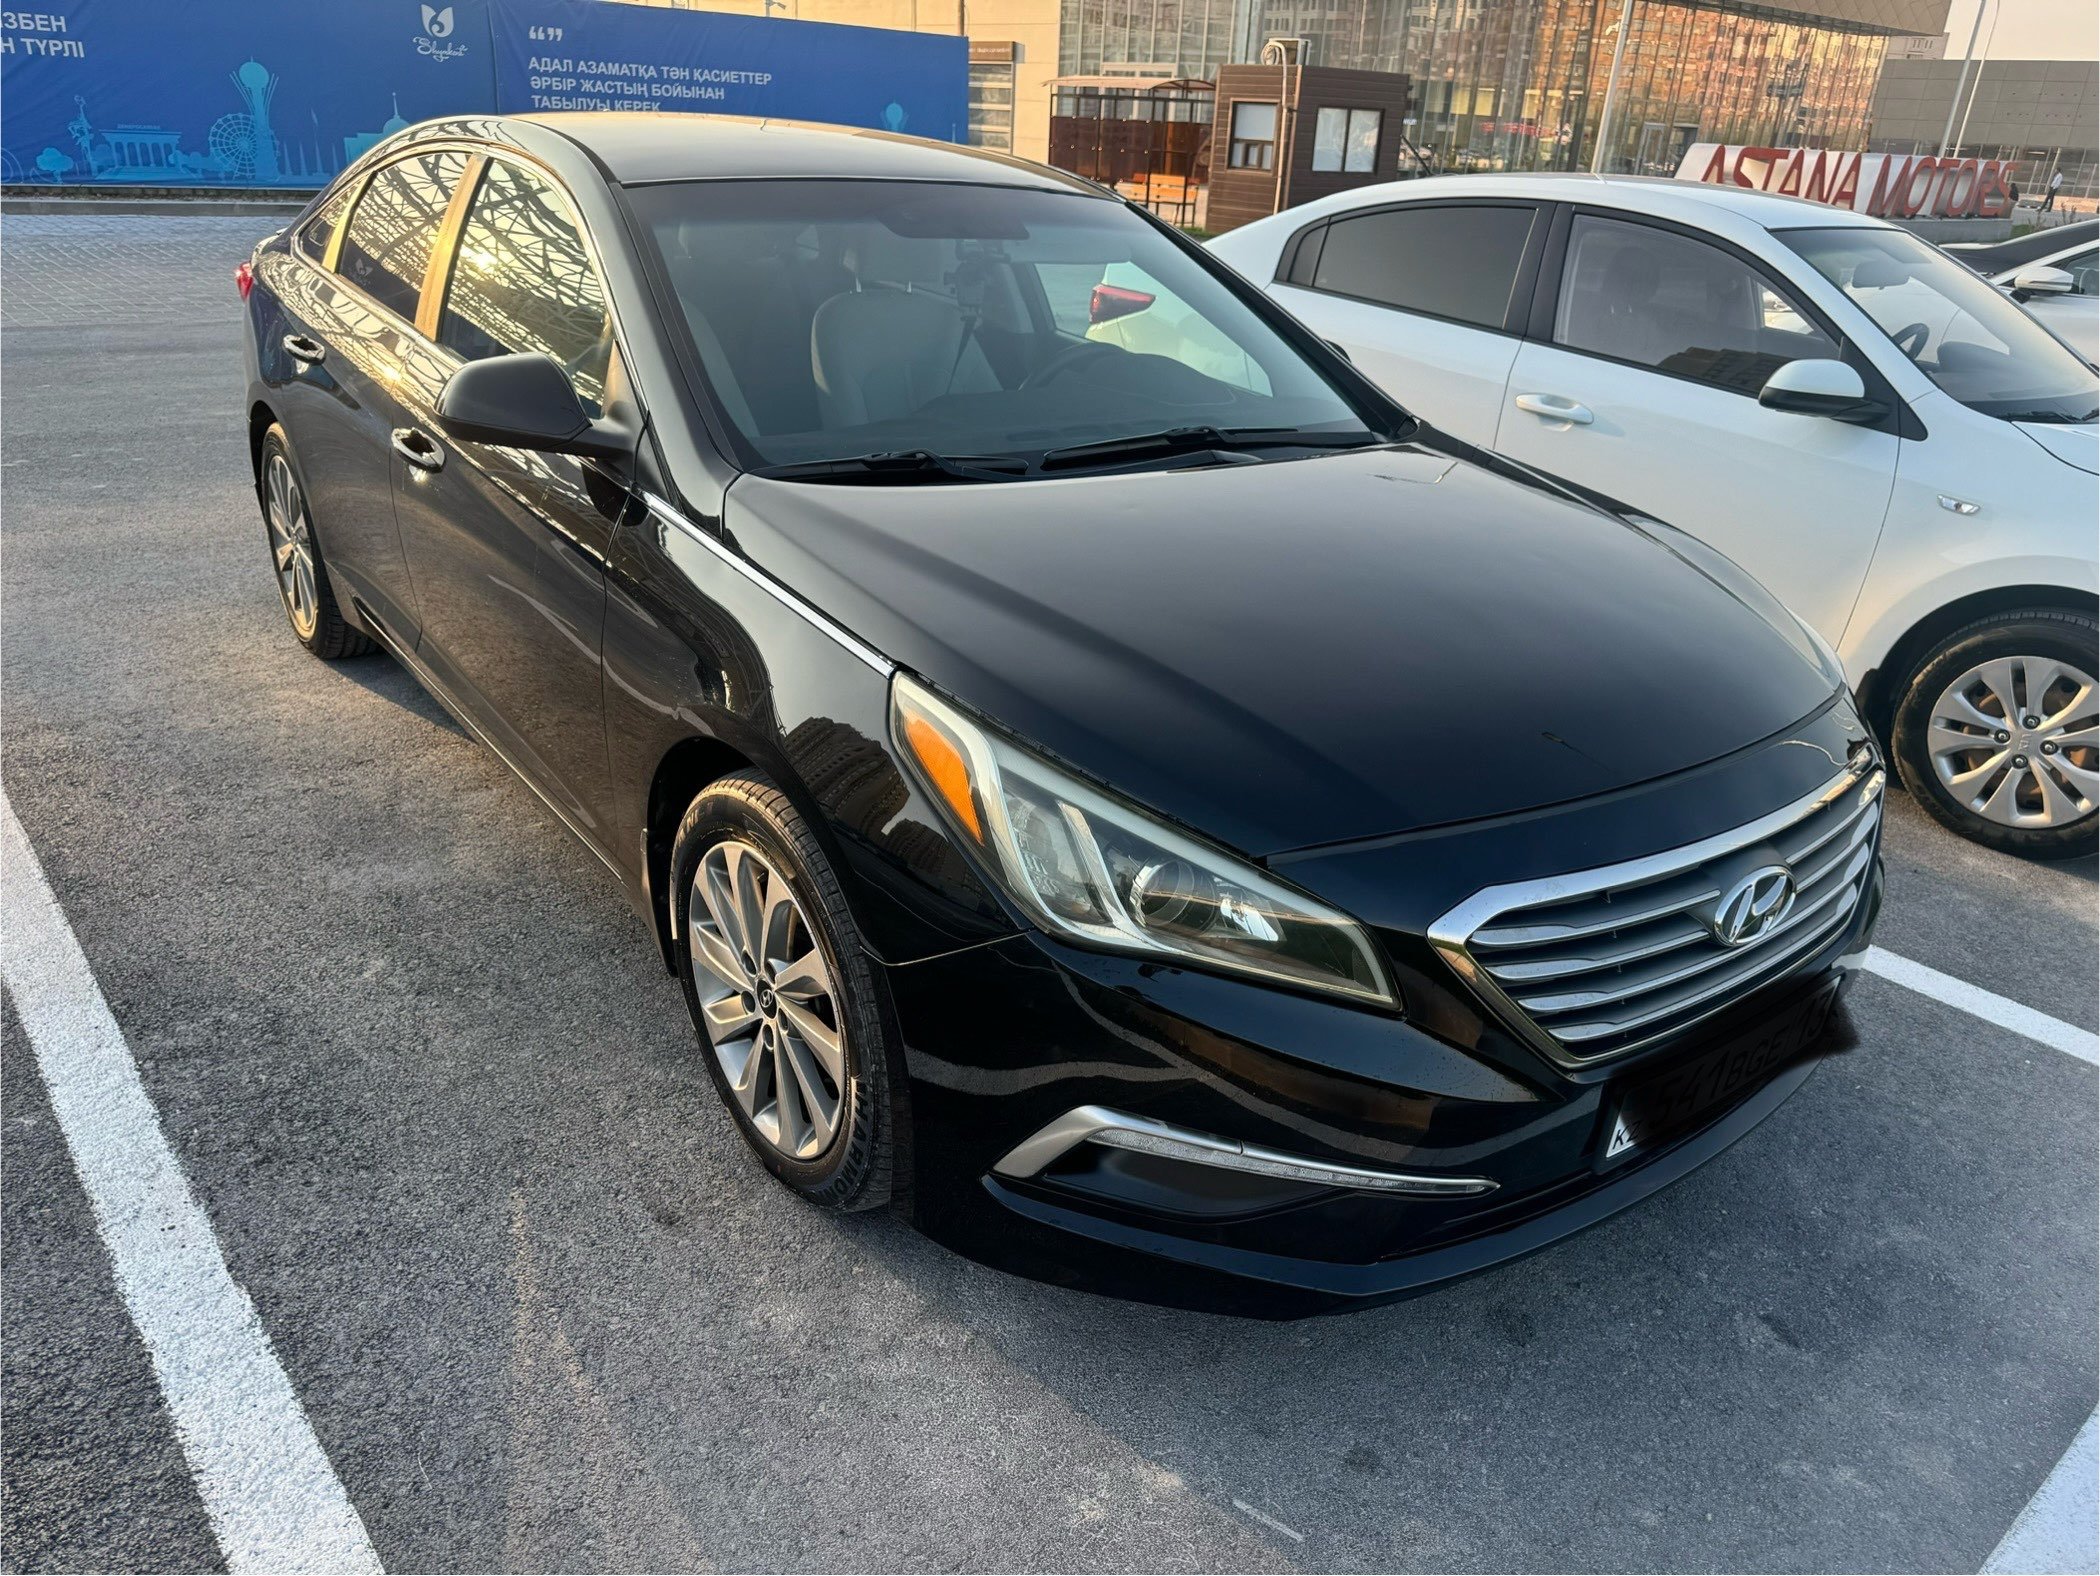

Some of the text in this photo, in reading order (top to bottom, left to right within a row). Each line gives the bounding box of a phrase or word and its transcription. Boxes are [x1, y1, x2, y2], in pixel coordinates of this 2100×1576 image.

[1, 11, 67, 33] ЗБЕН
[20, 37, 85, 58] ТҮРЛІ
[528, 56, 772, 86] АДАЛ АЗАМАТҚА ТӘН ҚАСИЕТТЕР
[530, 75, 725, 100] ӘРБІР ЖАСТЫҢ БОЙЫНАН
[531, 94, 662, 112] ТАБЫЛУЫ КЕРЕК
[1702, 144, 2018, 218] ASTANA MOTORS
